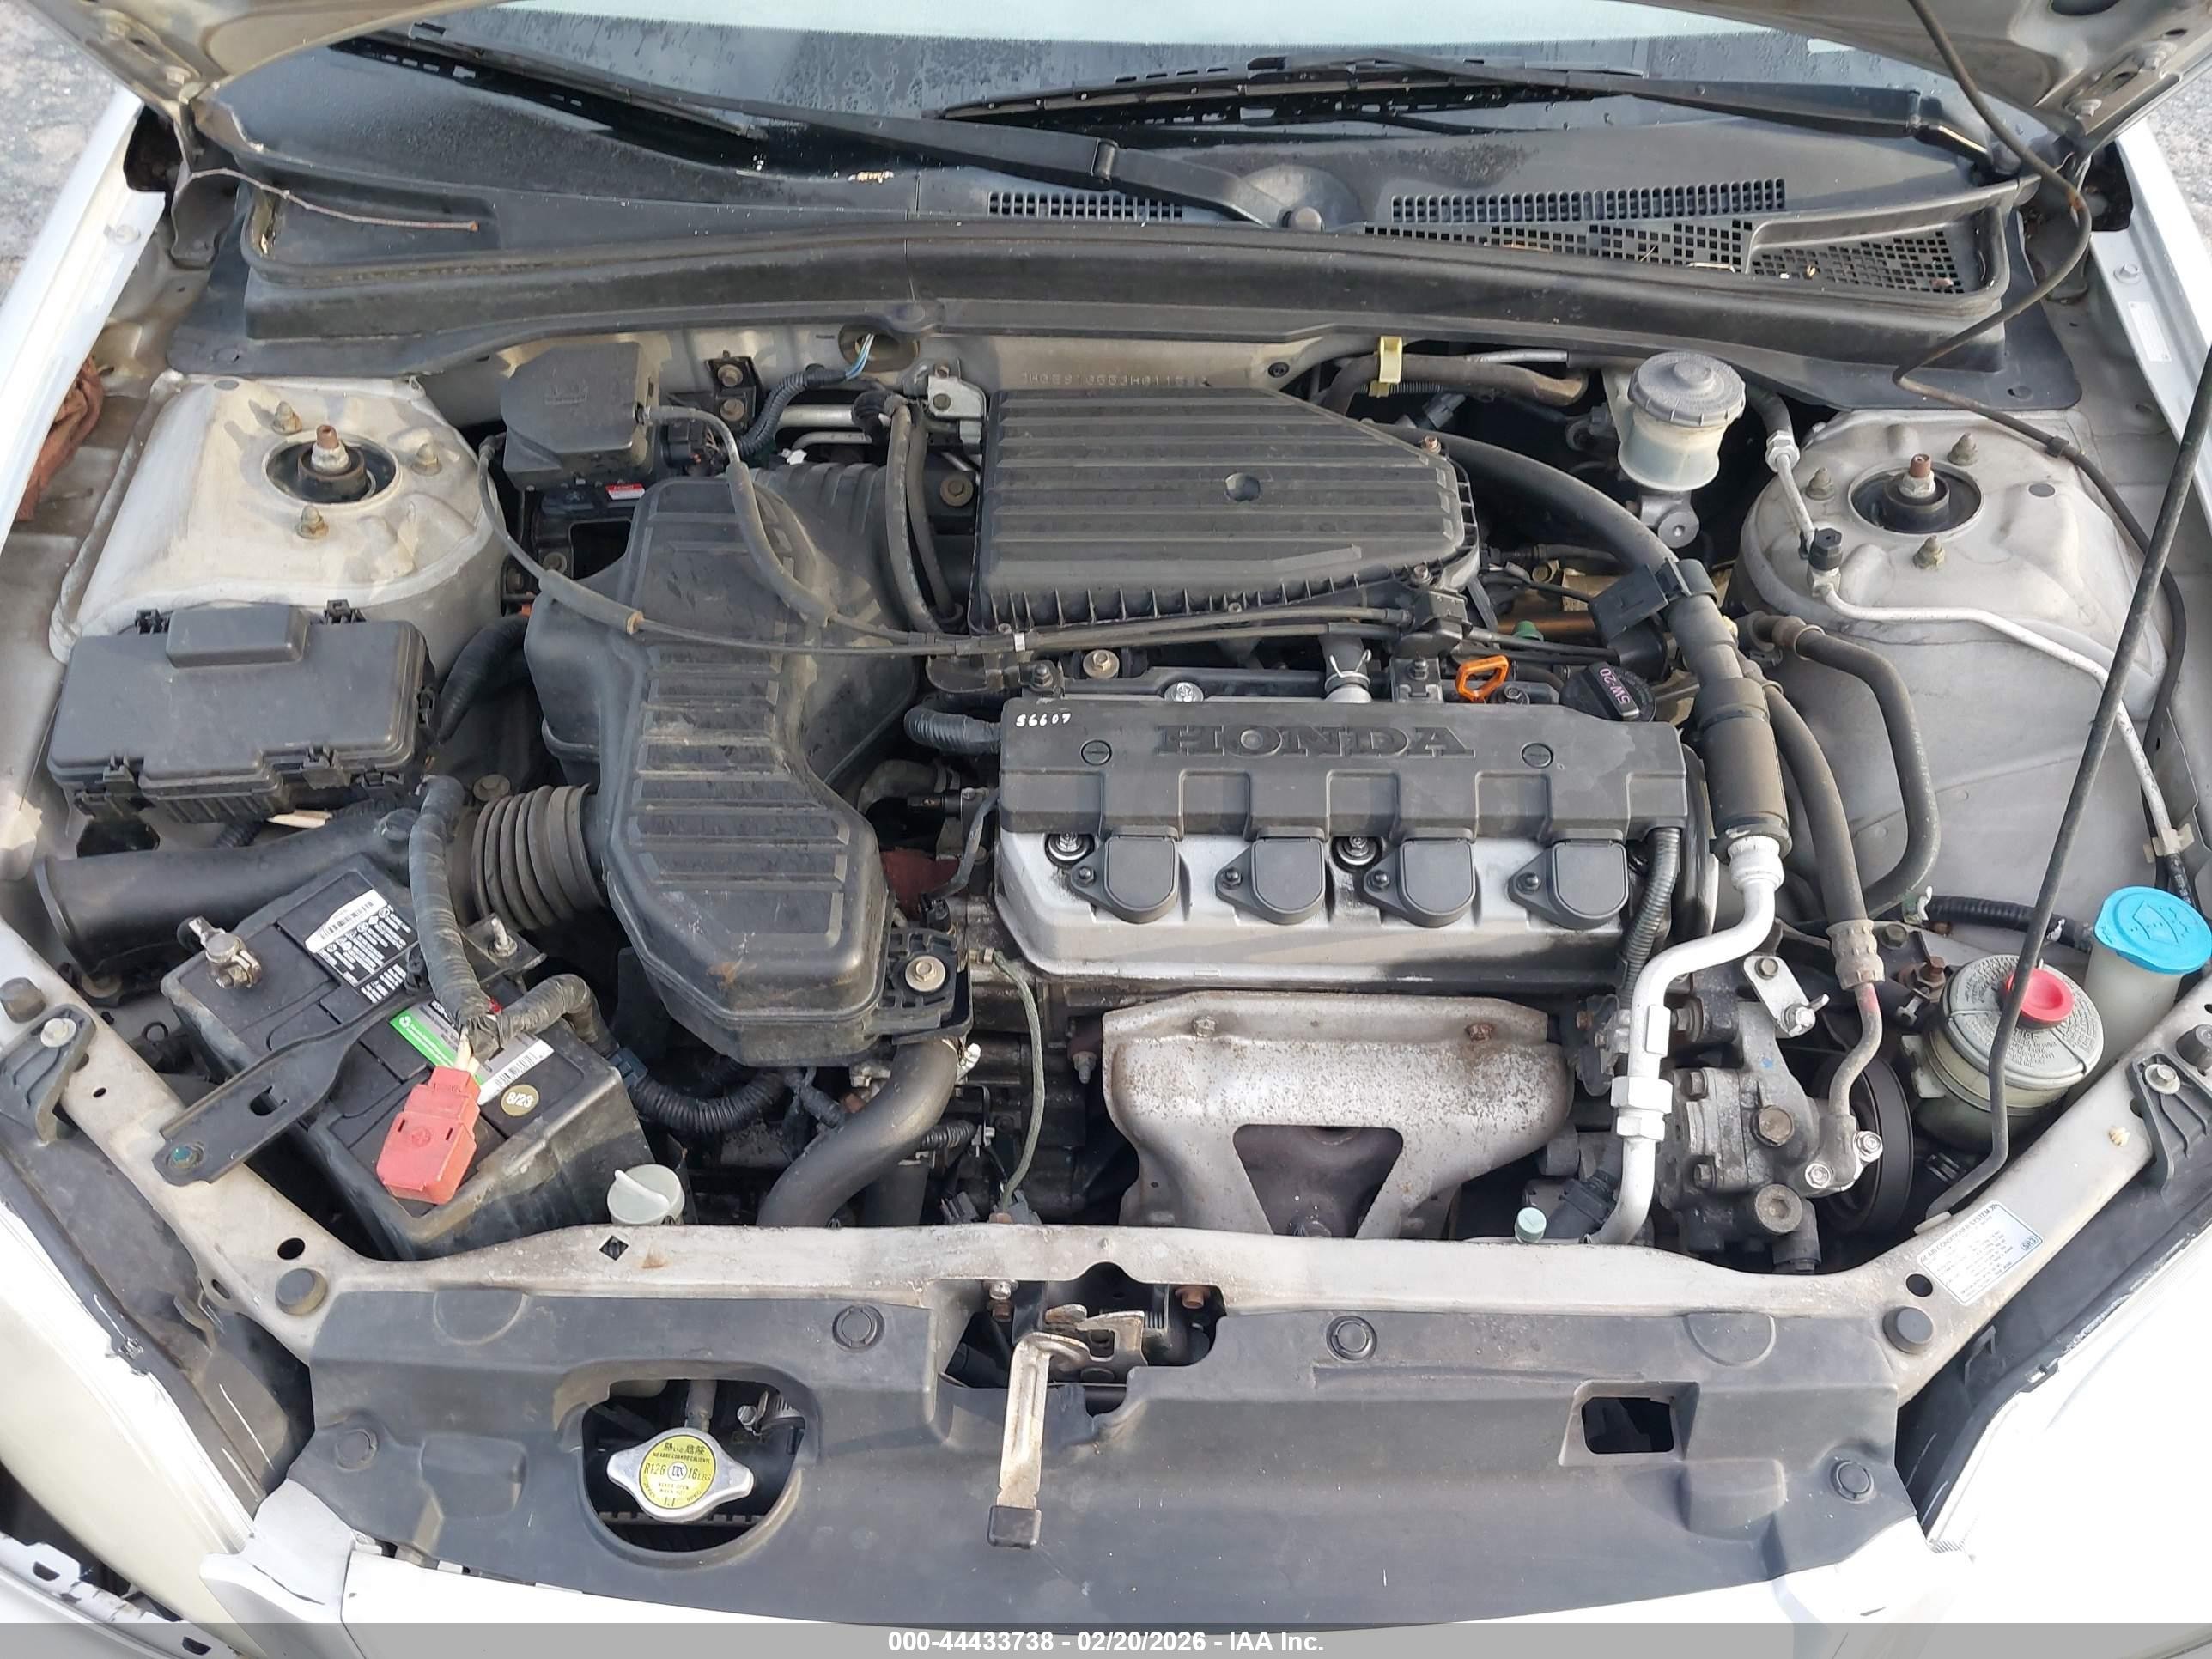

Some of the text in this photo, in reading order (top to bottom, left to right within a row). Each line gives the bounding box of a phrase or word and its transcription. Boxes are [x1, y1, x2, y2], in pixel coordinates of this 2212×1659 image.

[1600, 668, 1630, 704] 5W-20
[1154, 724, 1476, 759] HONDA
[506, 1092, 534, 1108] 8/23
